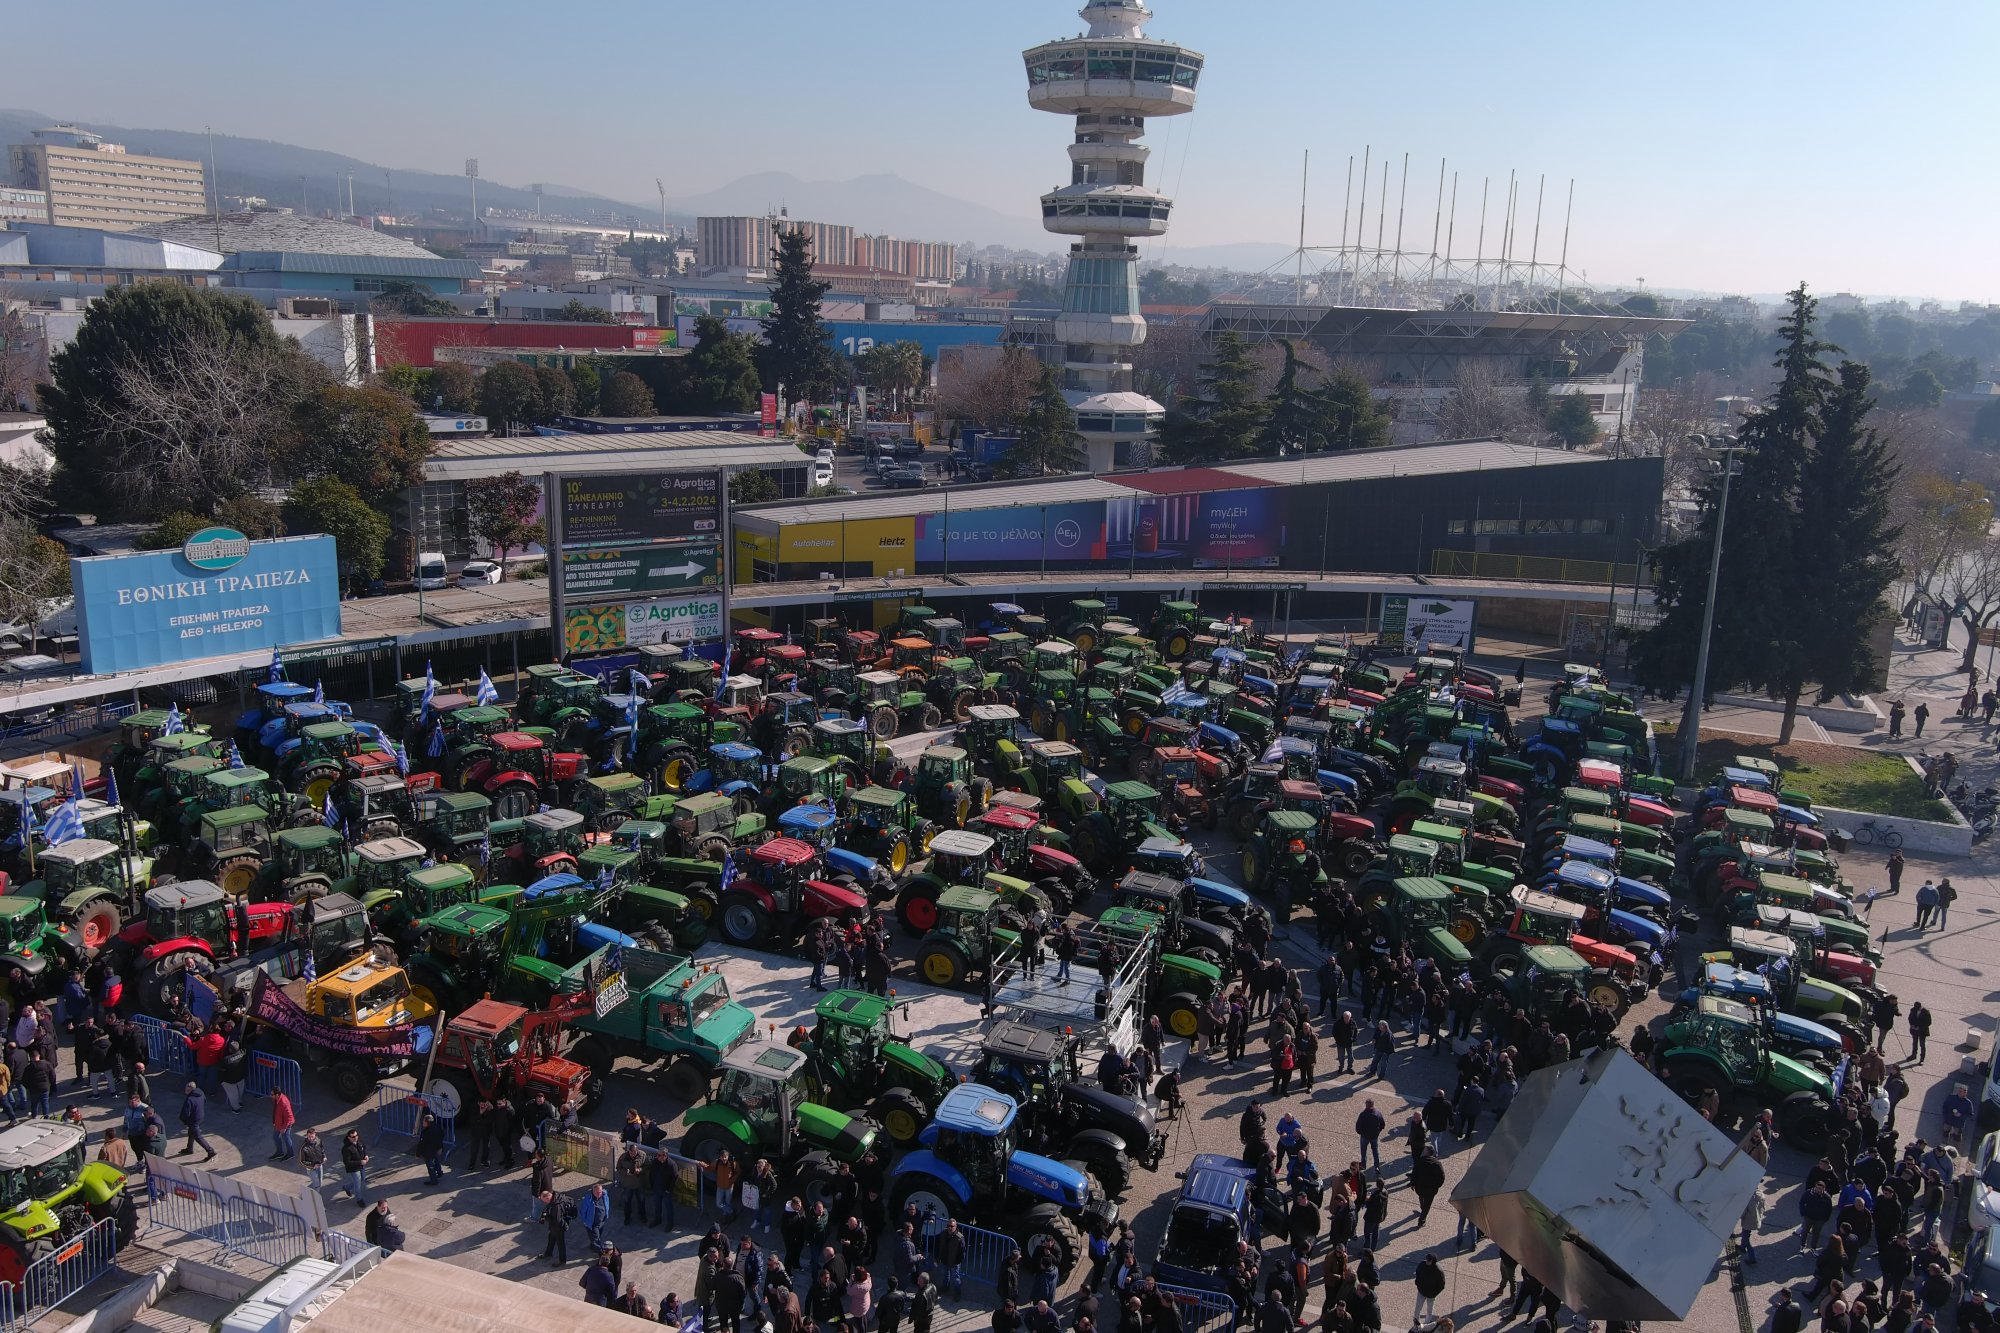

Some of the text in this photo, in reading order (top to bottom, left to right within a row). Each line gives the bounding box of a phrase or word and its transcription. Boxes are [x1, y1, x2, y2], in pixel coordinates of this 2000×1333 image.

[674, 477, 715, 489] Agrotica
[568, 492, 623, 503] ΠΑΝΕΛΛΗΝΙΟ
[661, 495, 717, 507] 3-4.2.2024
[568, 501, 624, 511] ΣΥΝΕΔΡΙΟ
[1210, 507, 1247, 519] myΔΕΗ
[569, 514, 617, 524] RE-THINKING
[1210, 522, 1237, 531] myWay
[936, 528, 1045, 542] Ένα με το μέλλον
[1057, 526, 1077, 540] ΔΕΗ
[792, 539, 836, 548] Autohellas
[879, 537, 906, 546] Hertz
[586, 570, 616, 578] ΣΥΝΕΔΡΙΑΚΟ
[117, 569, 311, 606] ΕΘΝΙΚΗ ΤΡΑΠΕΖΑ
[566, 579, 613, 588] ΙΩΑΝΝΗΣ ΒΕΛΛΙΔΗΣ
[170, 605, 270, 626] ΕΠΙΣΗΜΗ ΤΡΑΠΕΖΑ
[648, 602, 718, 621] Agrotica
[180, 627, 204, 639] ΔΕΘ
[213, 619, 263, 635] HELEXPO
[694, 626, 719, 637] 2024
[322, 648, 332, 656] ΑΠΟ
[1013, 1164, 1047, 1180] NEW HOLLAND
